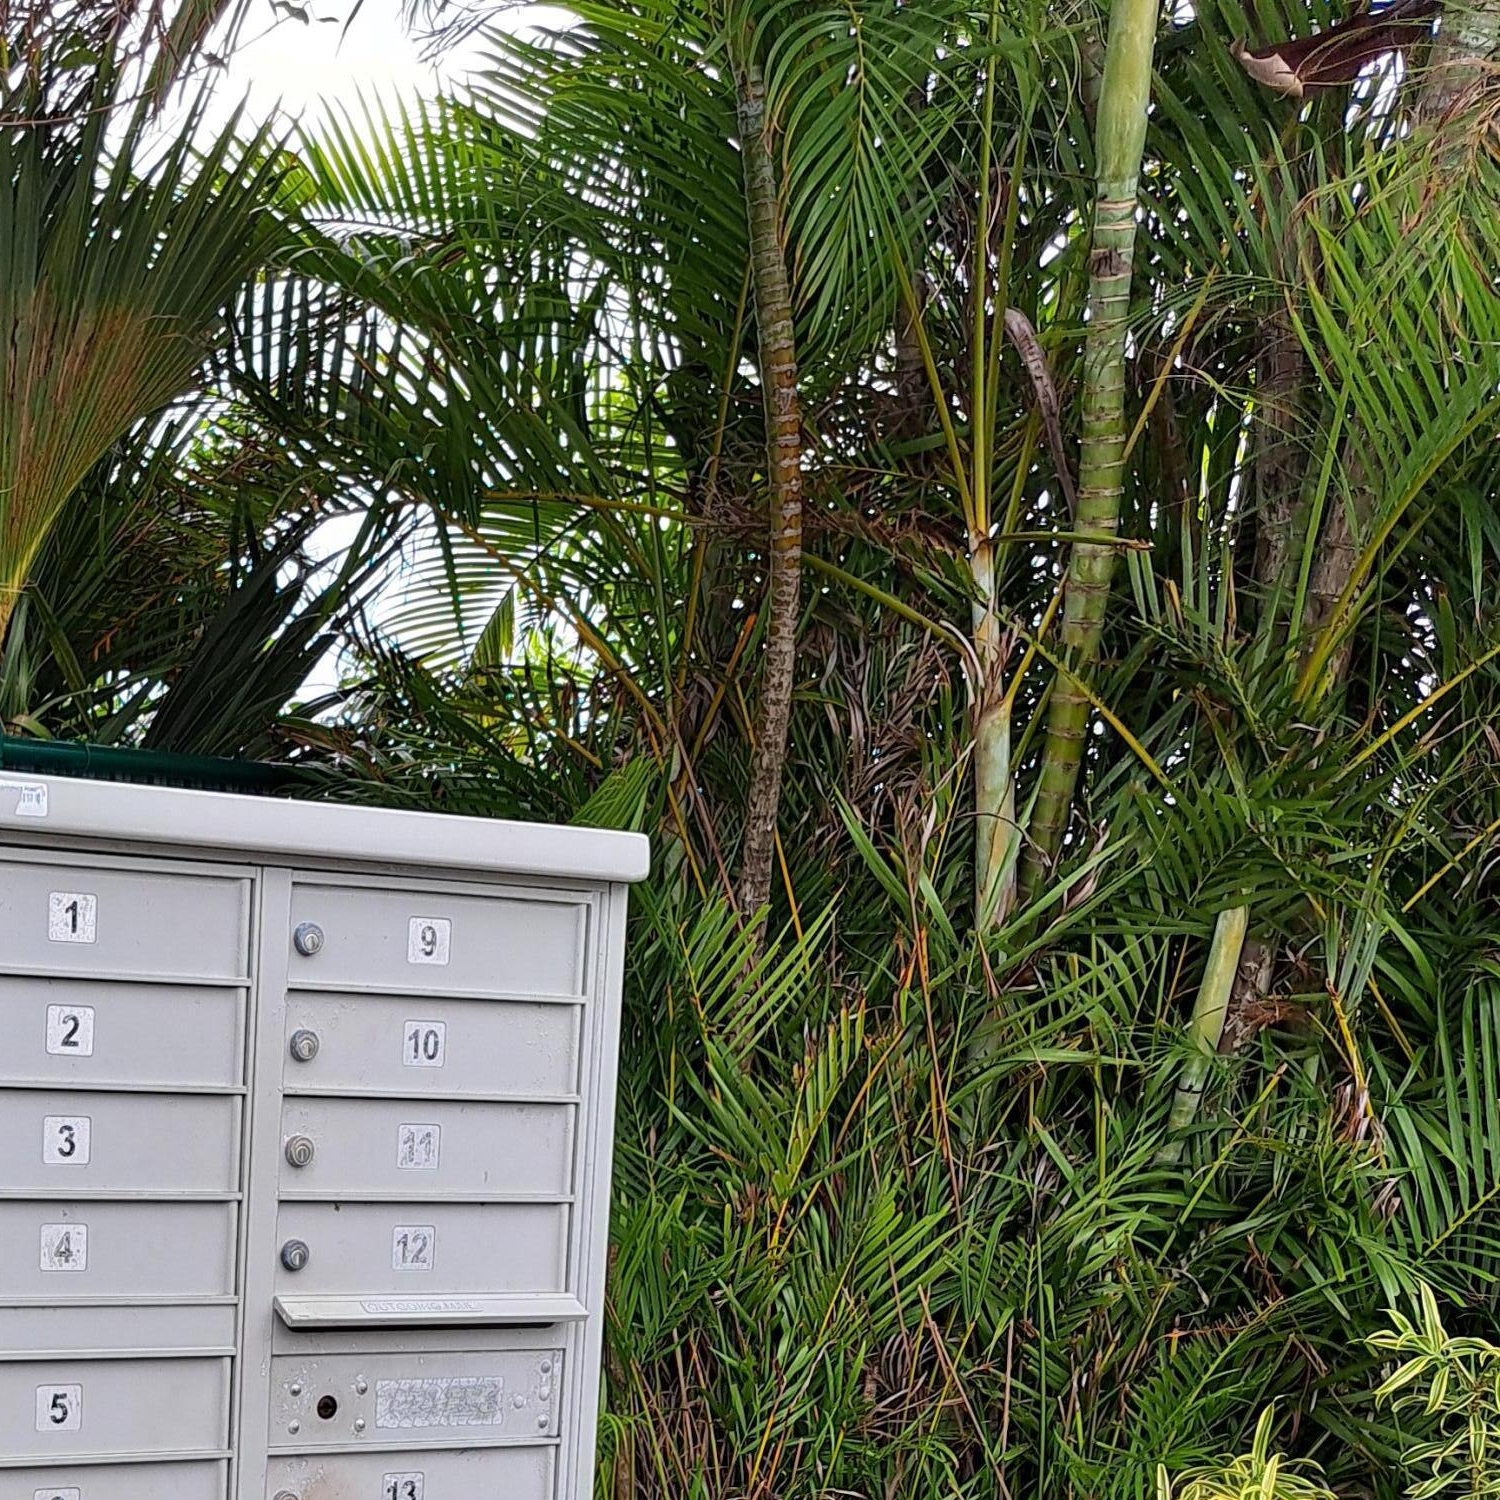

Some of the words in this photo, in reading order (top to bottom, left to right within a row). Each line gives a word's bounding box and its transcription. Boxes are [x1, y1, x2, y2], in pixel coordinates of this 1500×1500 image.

[64, 899, 79, 934] 1
[418, 925, 438, 957] 9
[60, 1014, 80, 1047] 2
[408, 1028, 440, 1061] 10
[57, 1123, 76, 1158] 3
[53, 1231, 74, 1264] 4
[396, 1233, 428, 1264] 12
[50, 1392, 69, 1424] 5
